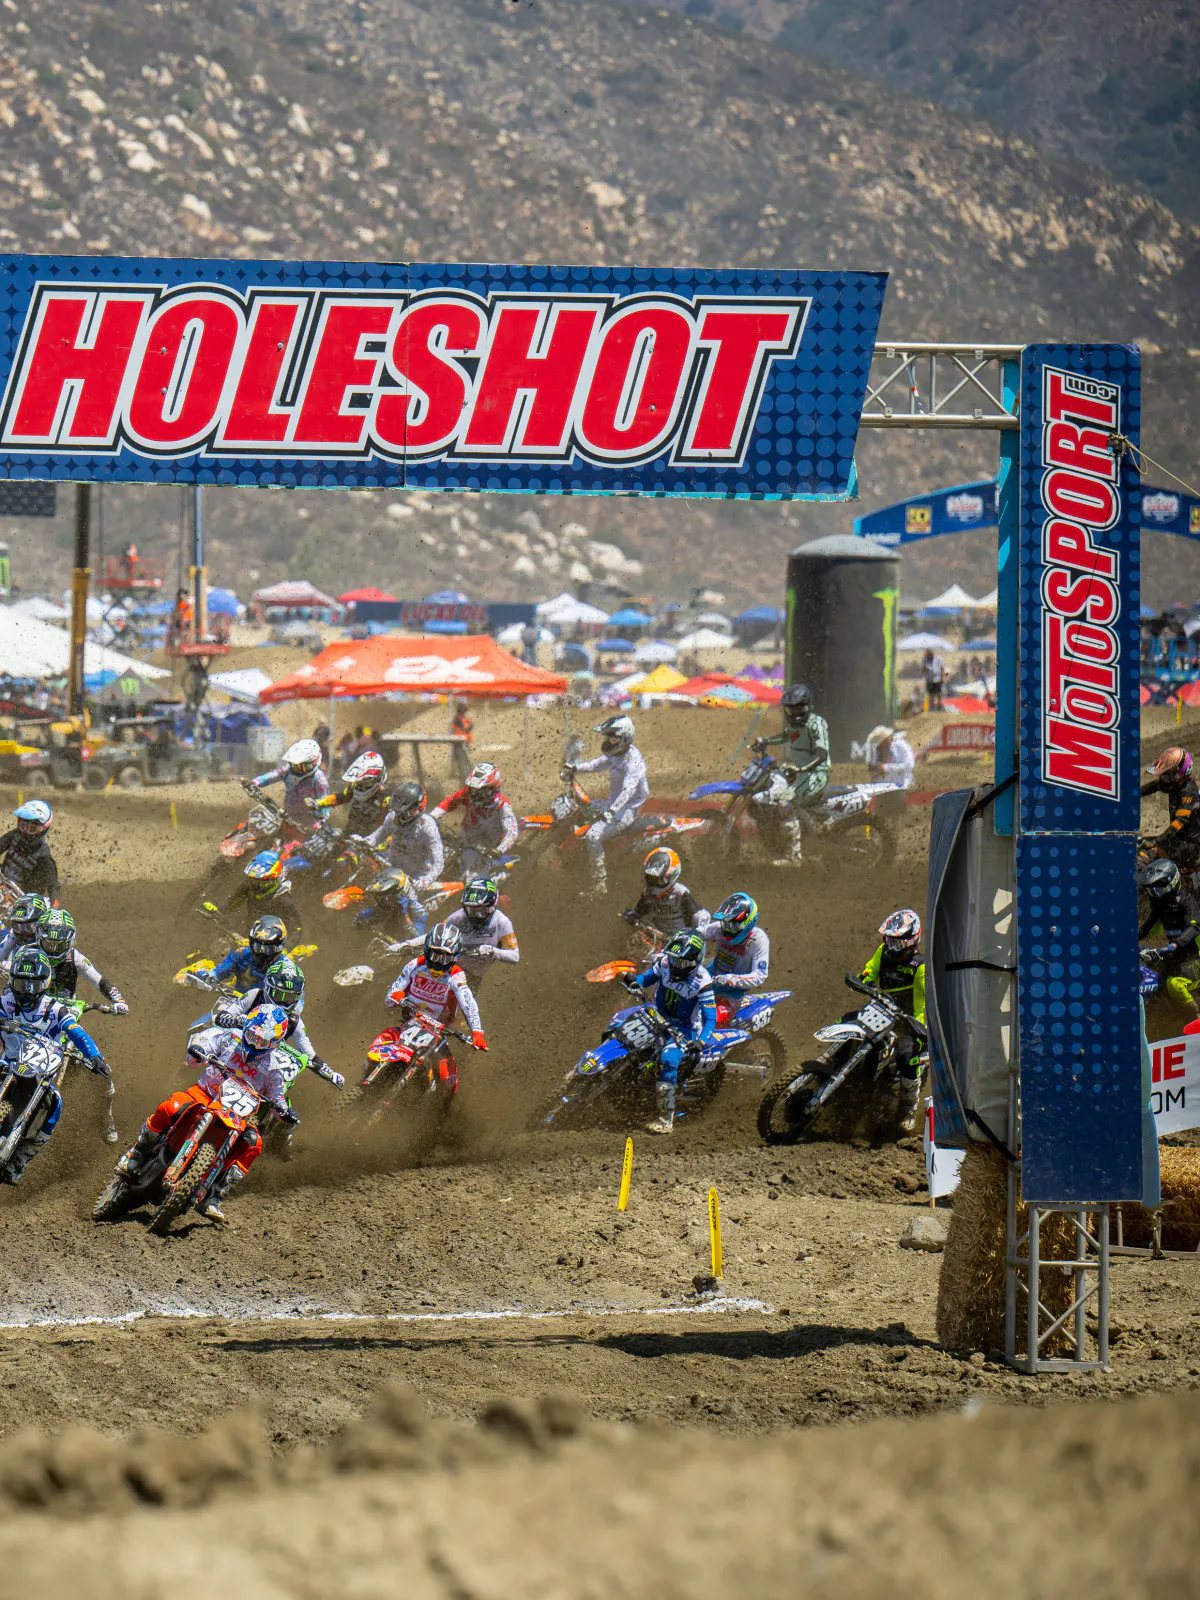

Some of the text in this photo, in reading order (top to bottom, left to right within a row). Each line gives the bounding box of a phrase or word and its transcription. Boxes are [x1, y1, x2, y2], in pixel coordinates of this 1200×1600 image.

[857, 1005, 893, 1032] 388
[400, 1026, 435, 1047] 44
[20, 1042, 62, 1073] 329
[231, 1052, 258, 1079] THOR
[221, 1087, 259, 1117] 25
